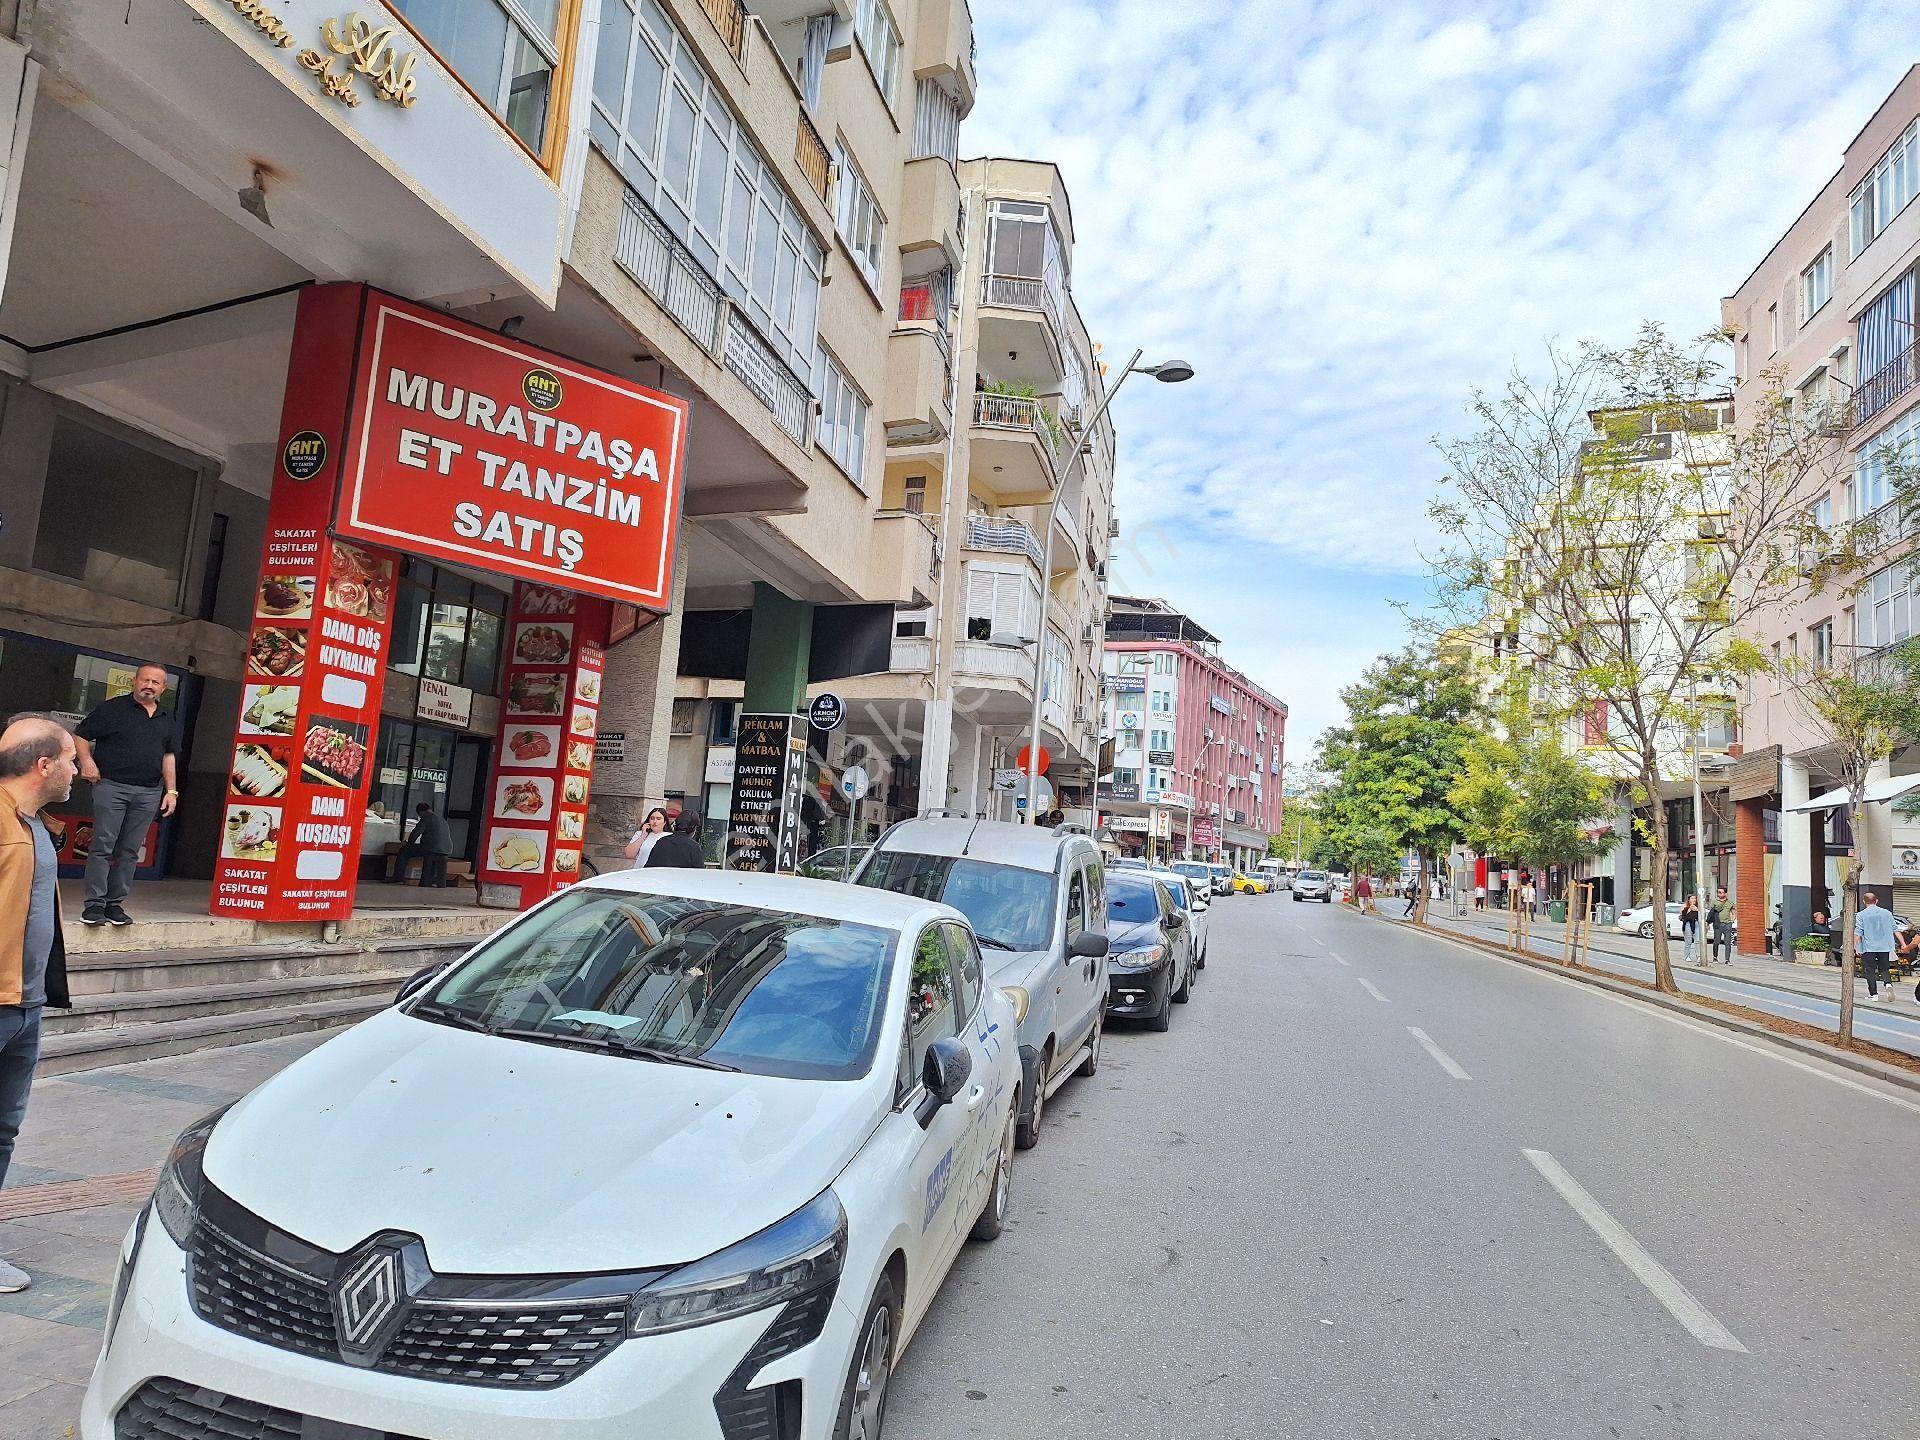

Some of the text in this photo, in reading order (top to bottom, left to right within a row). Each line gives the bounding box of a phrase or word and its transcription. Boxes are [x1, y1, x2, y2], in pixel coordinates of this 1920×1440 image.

[529, 375, 558, 393] ANT
[386, 367, 660, 482] MURATPAŞA
[289, 440, 321, 456] ANT
[398, 428, 641, 527] ET TANZİM
[274, 529, 317, 538] SAKATAT
[453, 501, 584, 571] SATIŞ
[269, 541, 318, 553] ÇEŞİTLERİ
[269, 557, 314, 566] BULUNUR
[321, 617, 381, 654] DANA DÖŞ
[319, 645, 377, 677] KIYMALIK
[422, 680, 448, 697] YENAL
[745, 720, 783, 730] REKLAM
[758, 731, 767, 743] &
[412, 768, 447, 782] YUFKACI
[311, 796, 345, 817] DANA
[782, 753, 800, 868] MATBAA
[296, 822, 351, 848] KUŞBAŞI
[735, 825, 770, 835] MAGNET
[224, 868, 267, 880] SAKATAT
[219, 882, 268, 895] ÇEŞİTLERİ
[282, 888, 347, 899] SAKATAT ÇEŞİTLERİ
[218, 897, 265, 909] BULUNUR
[298, 902, 330, 910] BULUNUR
